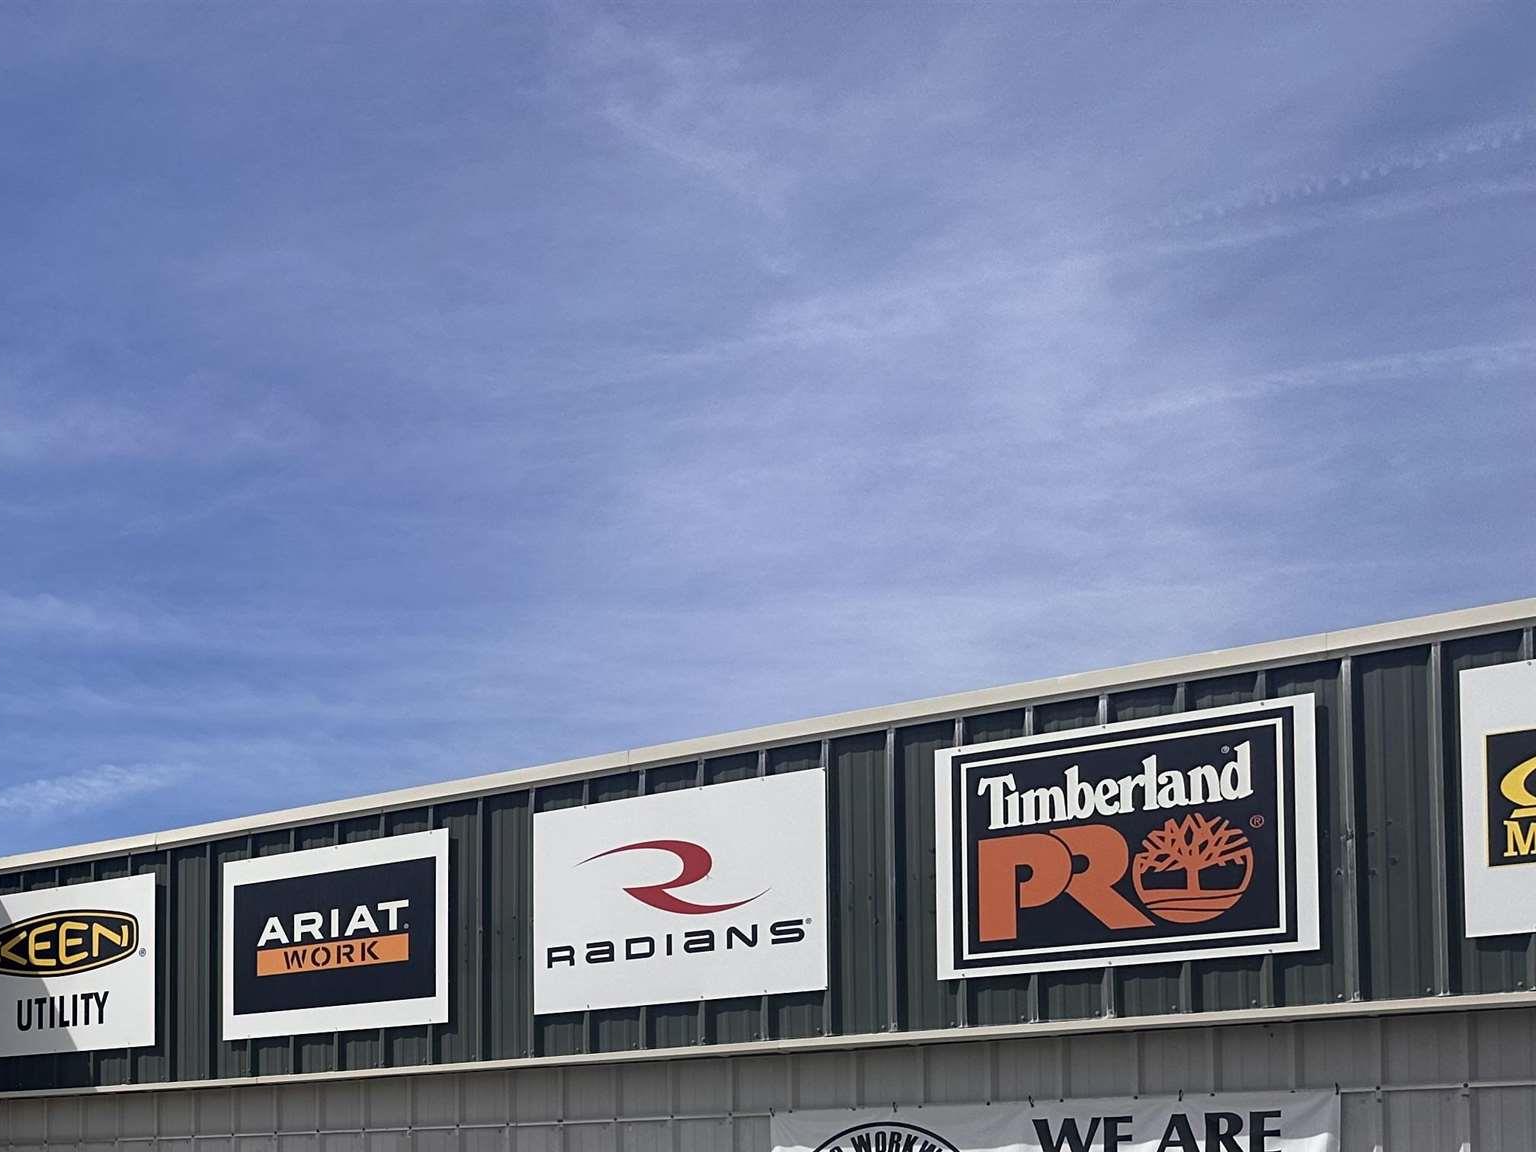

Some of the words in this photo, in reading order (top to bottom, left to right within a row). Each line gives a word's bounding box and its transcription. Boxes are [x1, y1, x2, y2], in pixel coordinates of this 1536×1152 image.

[977, 741, 1254, 830] Timberland
[257, 899, 409, 947] ARIAT
[284, 940, 380, 970] WORK
[17, 991, 109, 1031] UTILITY
